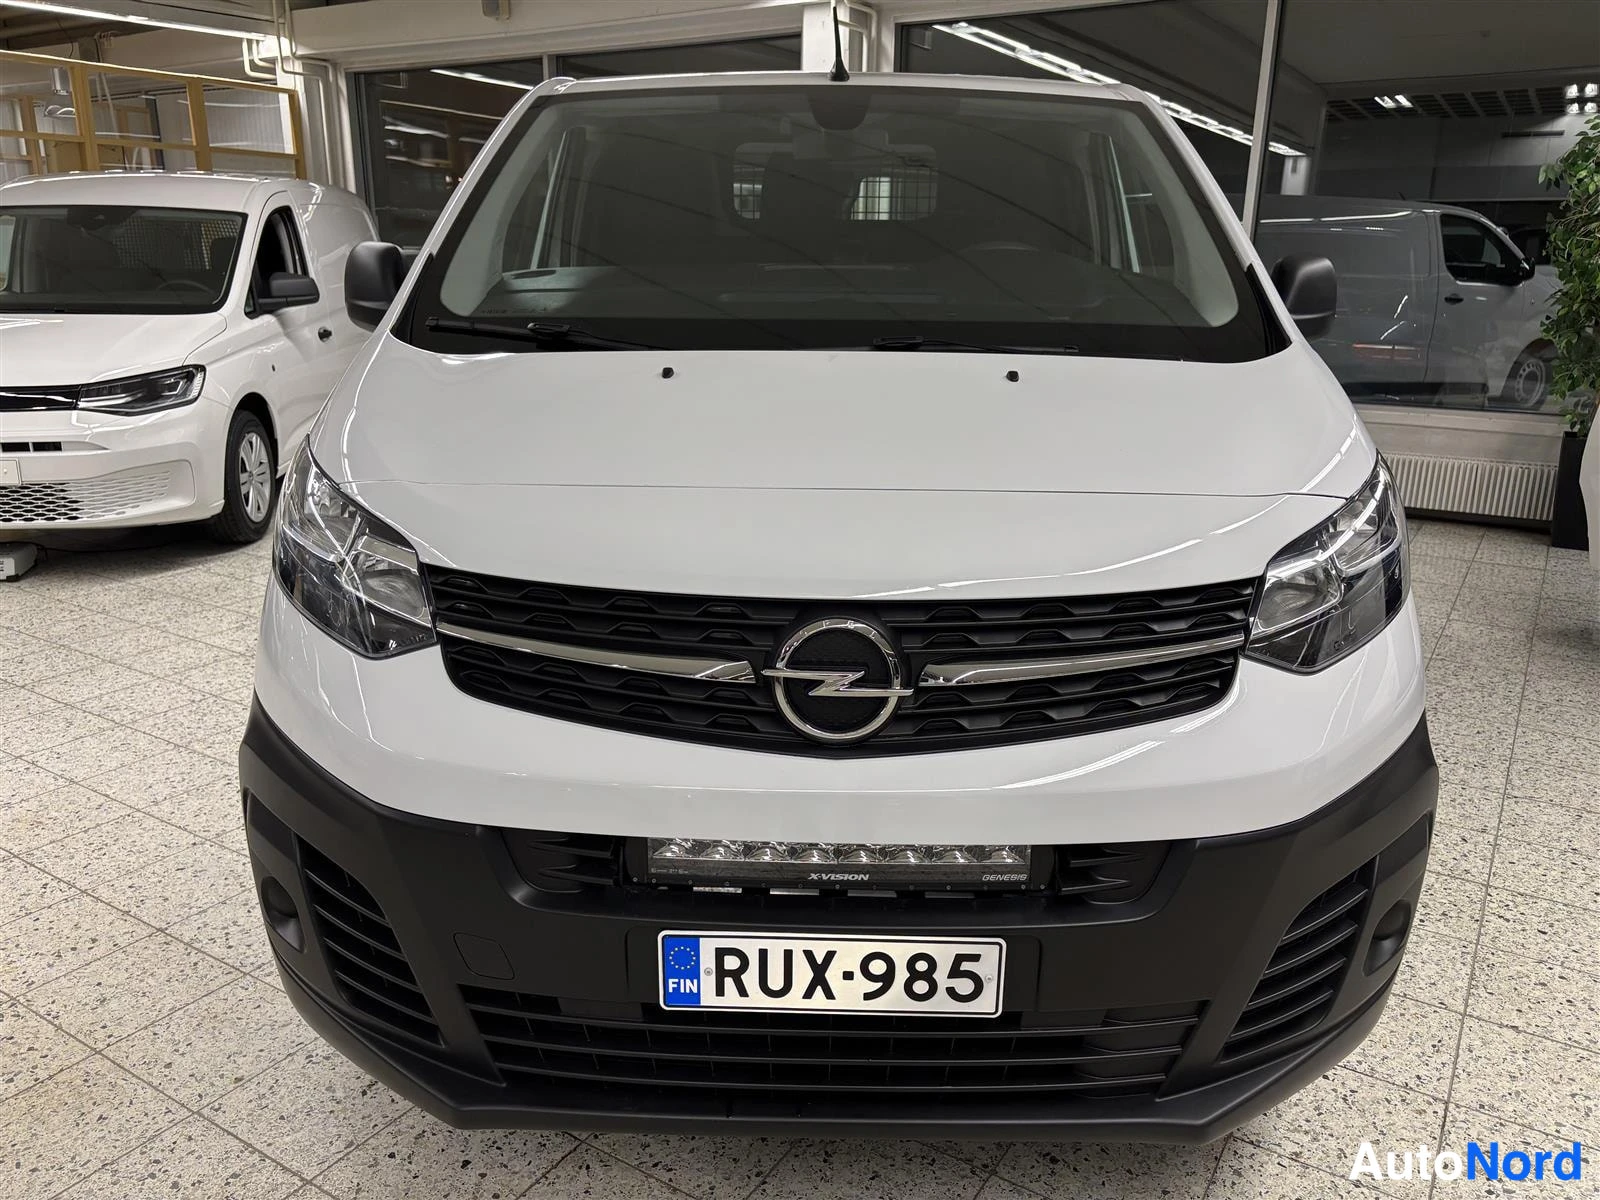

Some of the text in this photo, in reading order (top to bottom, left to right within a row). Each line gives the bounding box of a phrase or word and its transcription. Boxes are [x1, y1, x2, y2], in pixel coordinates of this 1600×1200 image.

[808, 873, 870, 881] X-VISION
[714, 947, 984, 1003] RUX-985
[668, 978, 698, 994] FIN
